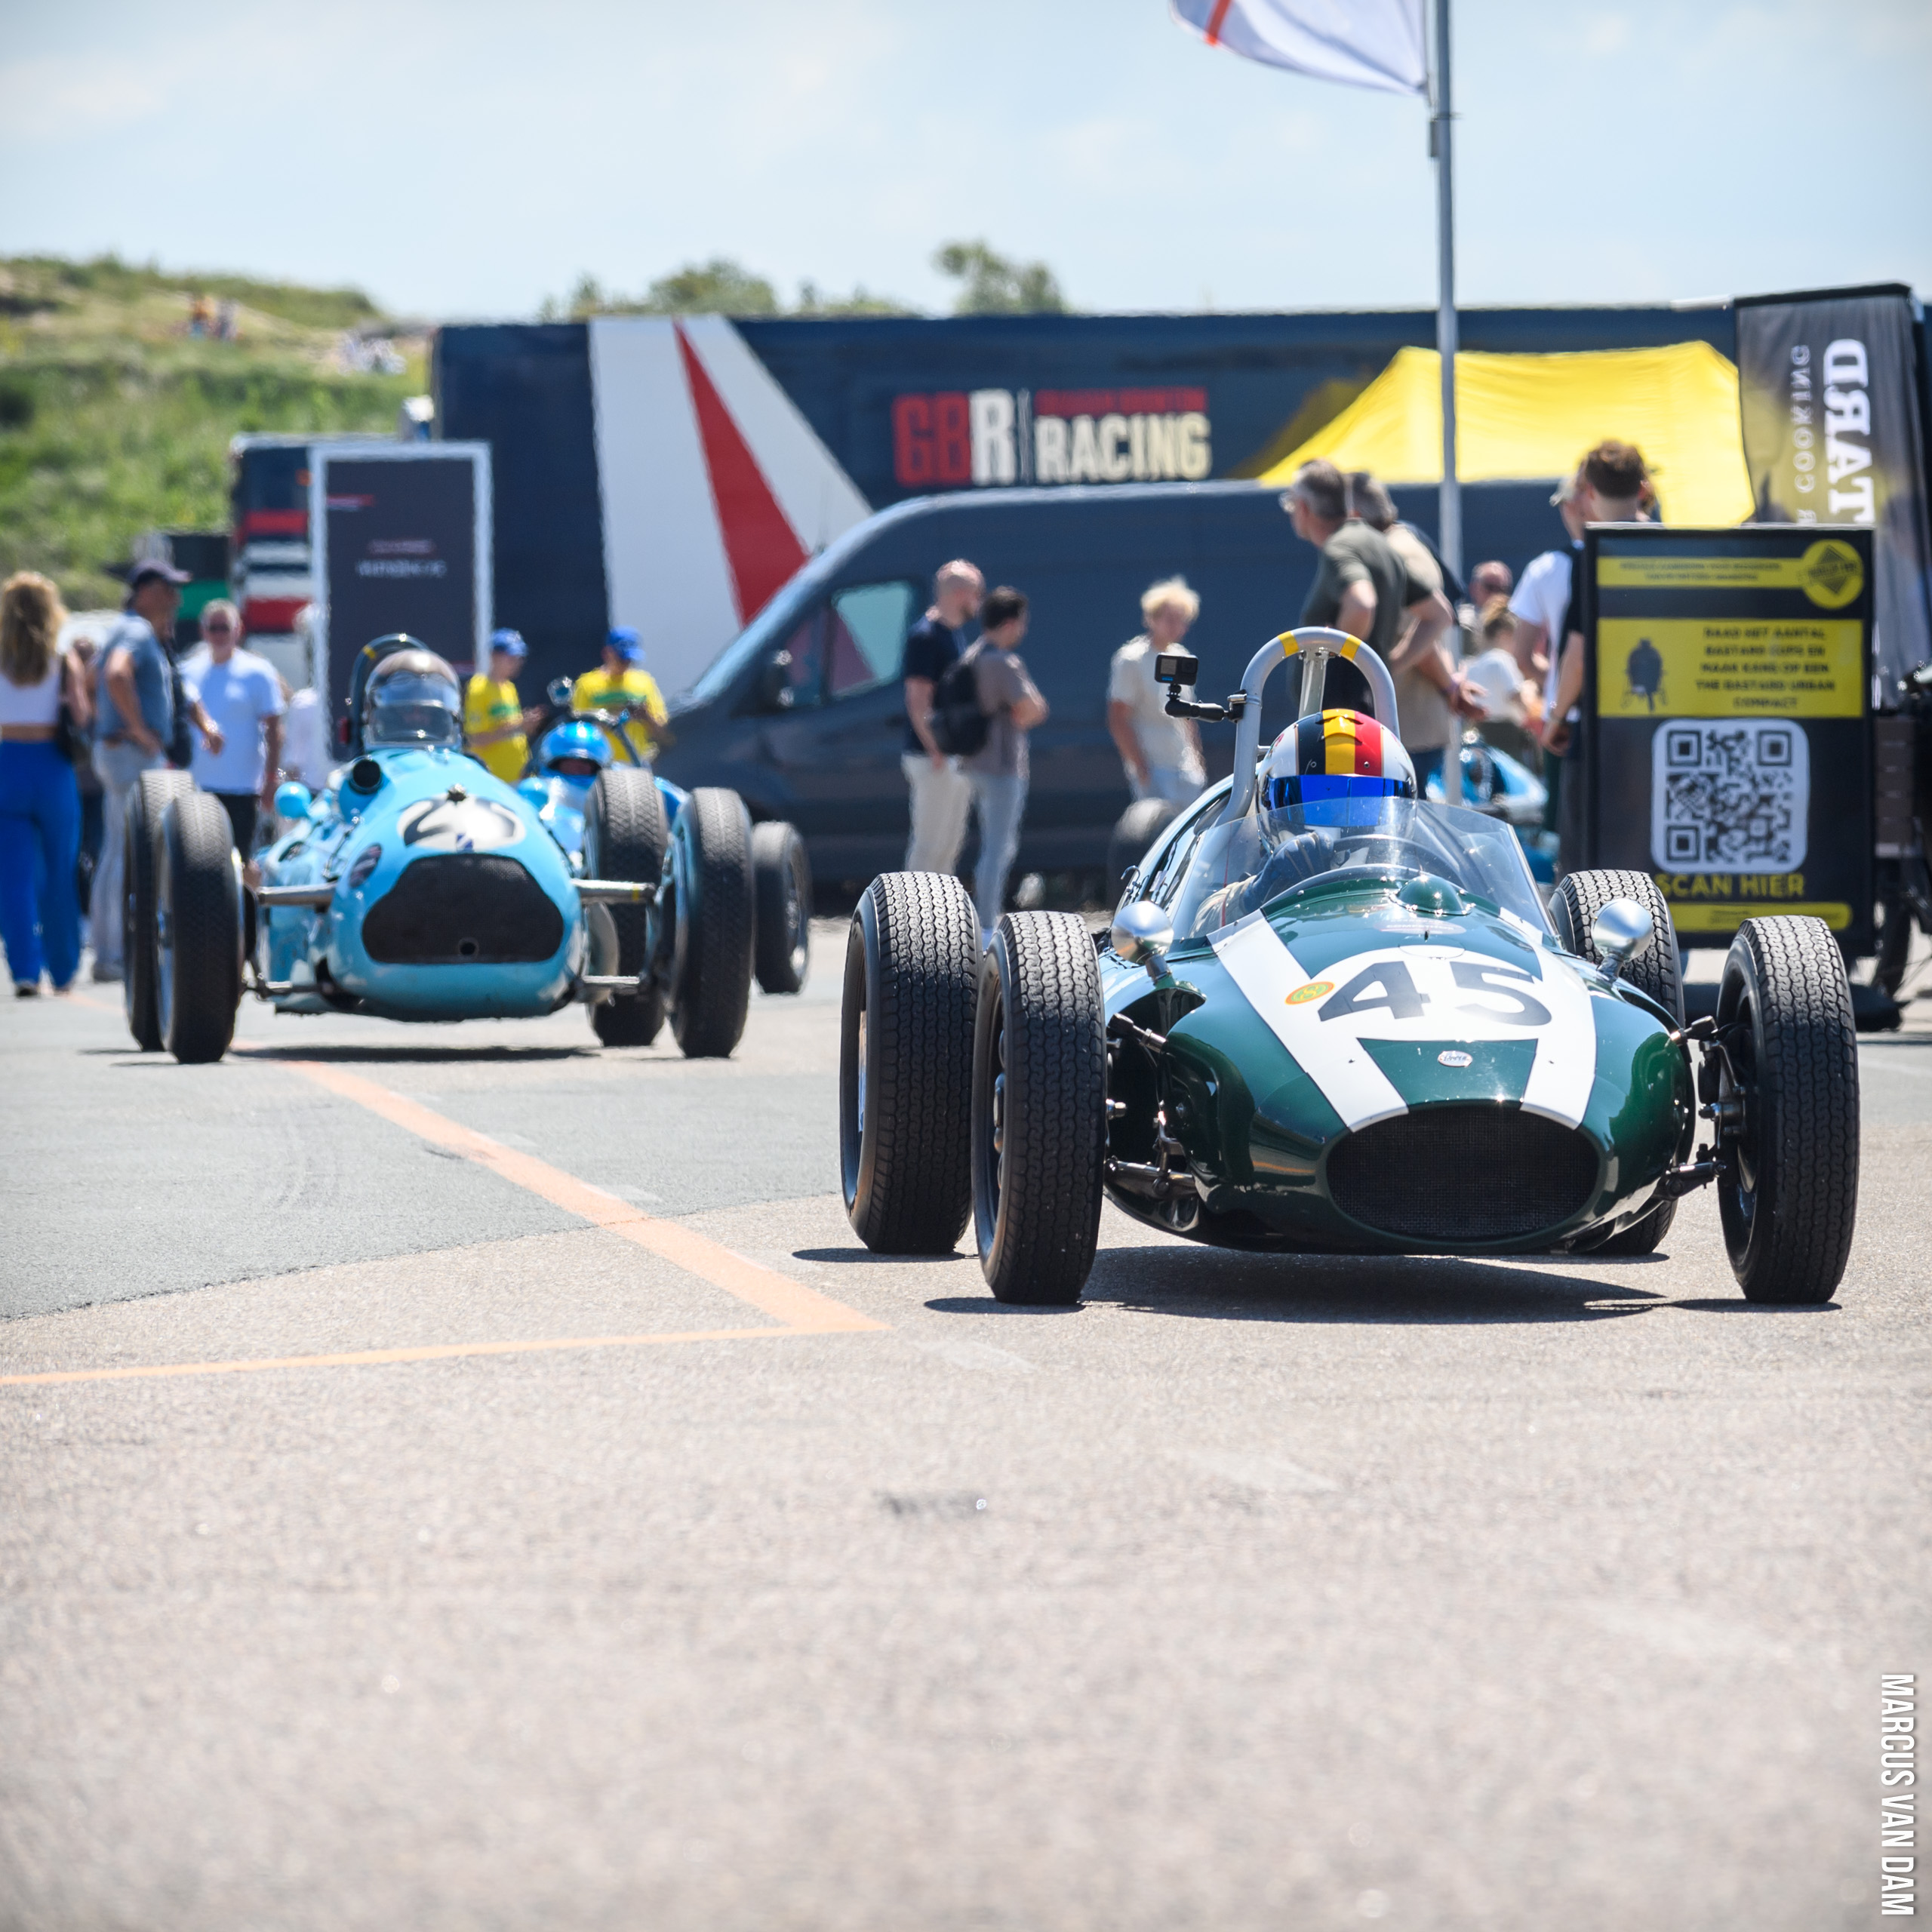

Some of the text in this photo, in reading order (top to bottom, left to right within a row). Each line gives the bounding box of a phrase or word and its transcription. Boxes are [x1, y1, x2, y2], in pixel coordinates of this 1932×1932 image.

[1033, 412, 1211, 484] RACING
[1654, 873, 1804, 897] SCAN HIER
[1318, 961, 1552, 1026] 45
